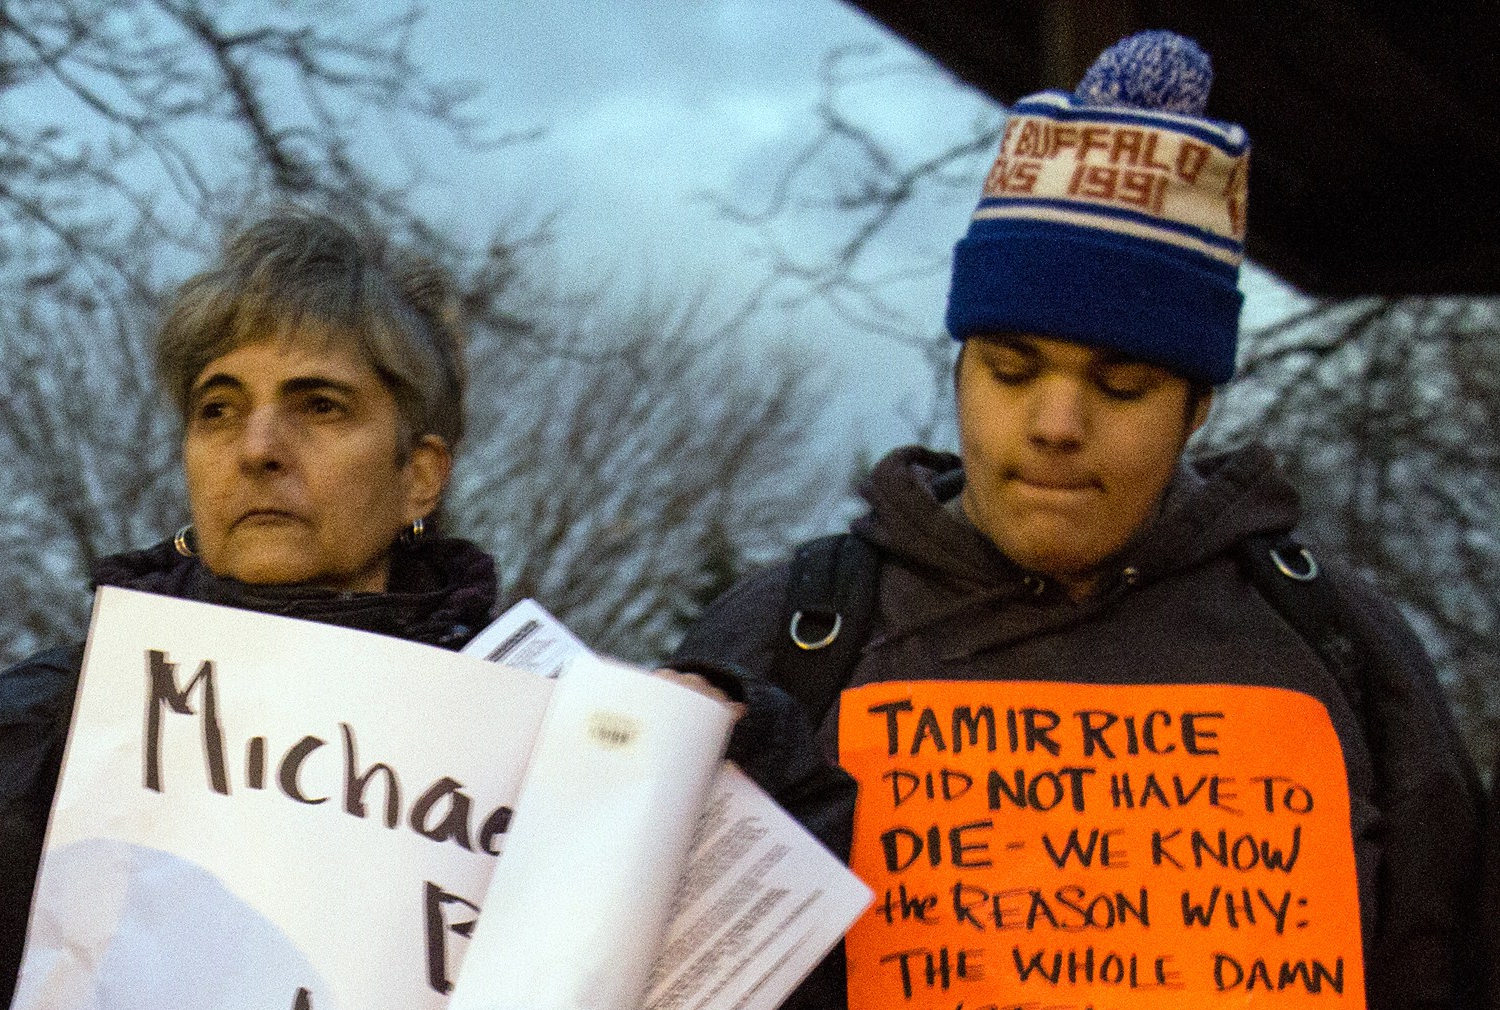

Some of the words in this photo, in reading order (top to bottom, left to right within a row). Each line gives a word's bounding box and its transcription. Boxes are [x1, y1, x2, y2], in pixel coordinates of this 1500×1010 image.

[1014, 119, 1211, 184] BUFFALO
[1067, 164, 1169, 217] 1991
[867, 699, 1062, 757] TAMIR
[1073, 708, 1225, 758] RICE
[882, 768, 973, 807] DID
[986, 766, 1097, 815] NOT
[1108, 772, 1245, 816] HAVE
[1250, 776, 1314, 815] TO
[1041, 828, 1131, 869] WE
[1151, 826, 1302, 874] KNOW
[951, 881, 1150, 933] REASON
[1181, 886, 1310, 936] WHY:
[880, 947, 984, 1000] THE
[1011, 945, 1186, 992] WHOLE
[1213, 953, 1346, 994] DAMN
